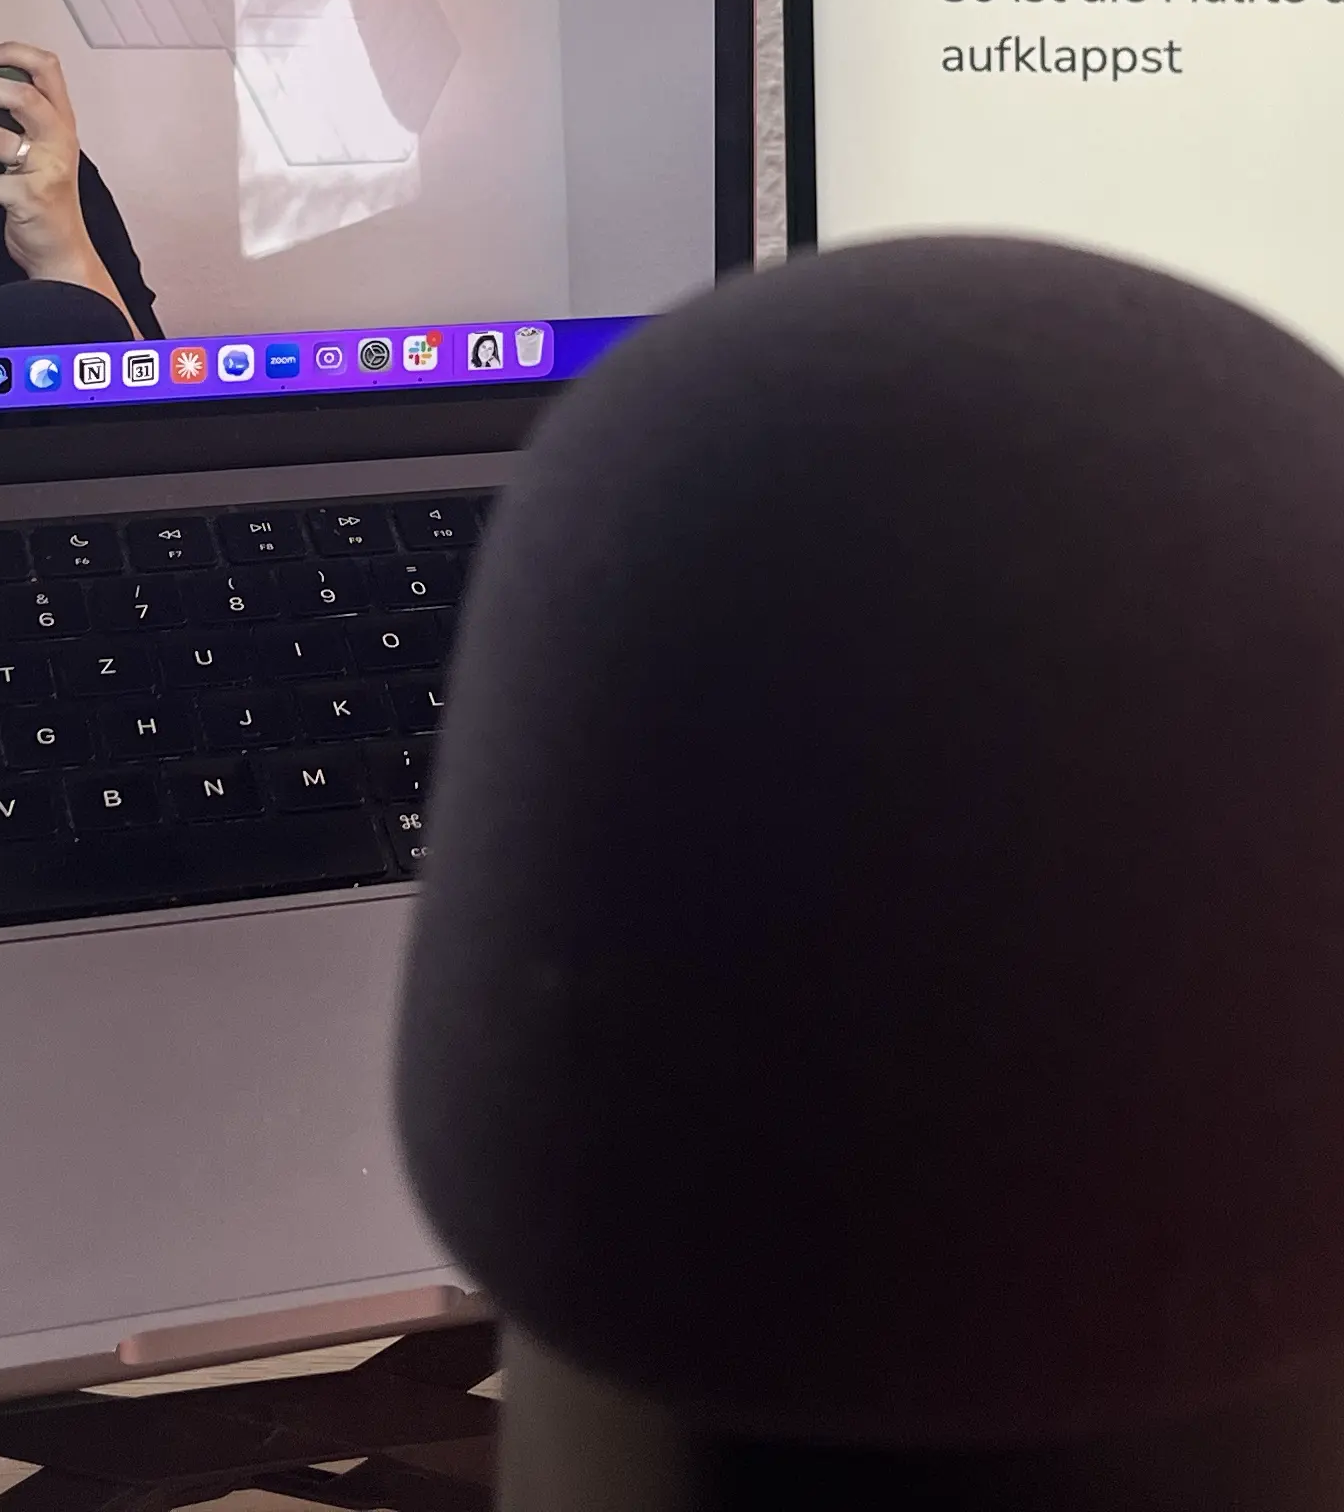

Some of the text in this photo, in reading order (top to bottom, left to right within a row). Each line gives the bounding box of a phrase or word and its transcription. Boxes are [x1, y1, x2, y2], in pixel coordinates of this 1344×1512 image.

[942, 35, 1183, 82] aufklappst
[87, 365, 102, 381] N
[135, 364, 151, 379] 31
[269, 355, 297, 366] zoom
[75, 557, 90, 565] F6
[168, 550, 182, 558] F7
[259, 543, 274, 551] F8
[348, 536, 363, 544] F9
[433, 529, 453, 538] F10
[36, 593, 49, 605] &
[38, 612, 55, 627] 6
[135, 604, 149, 619] 7
[229, 596, 245, 611] 8
[320, 589, 336, 603] 9
[411, 581, 426, 595] 0
[98, 658, 117, 675] Z
[194, 649, 213, 665] U
[382, 633, 400, 648] O
[36, 728, 55, 745] G
[137, 718, 157, 735] H
[239, 709, 252, 726] J
[332, 700, 351, 716] K
[428, 691, 444, 706] L
[103, 789, 122, 807] B
[203, 778, 224, 797] N
[302, 768, 326, 787] M
